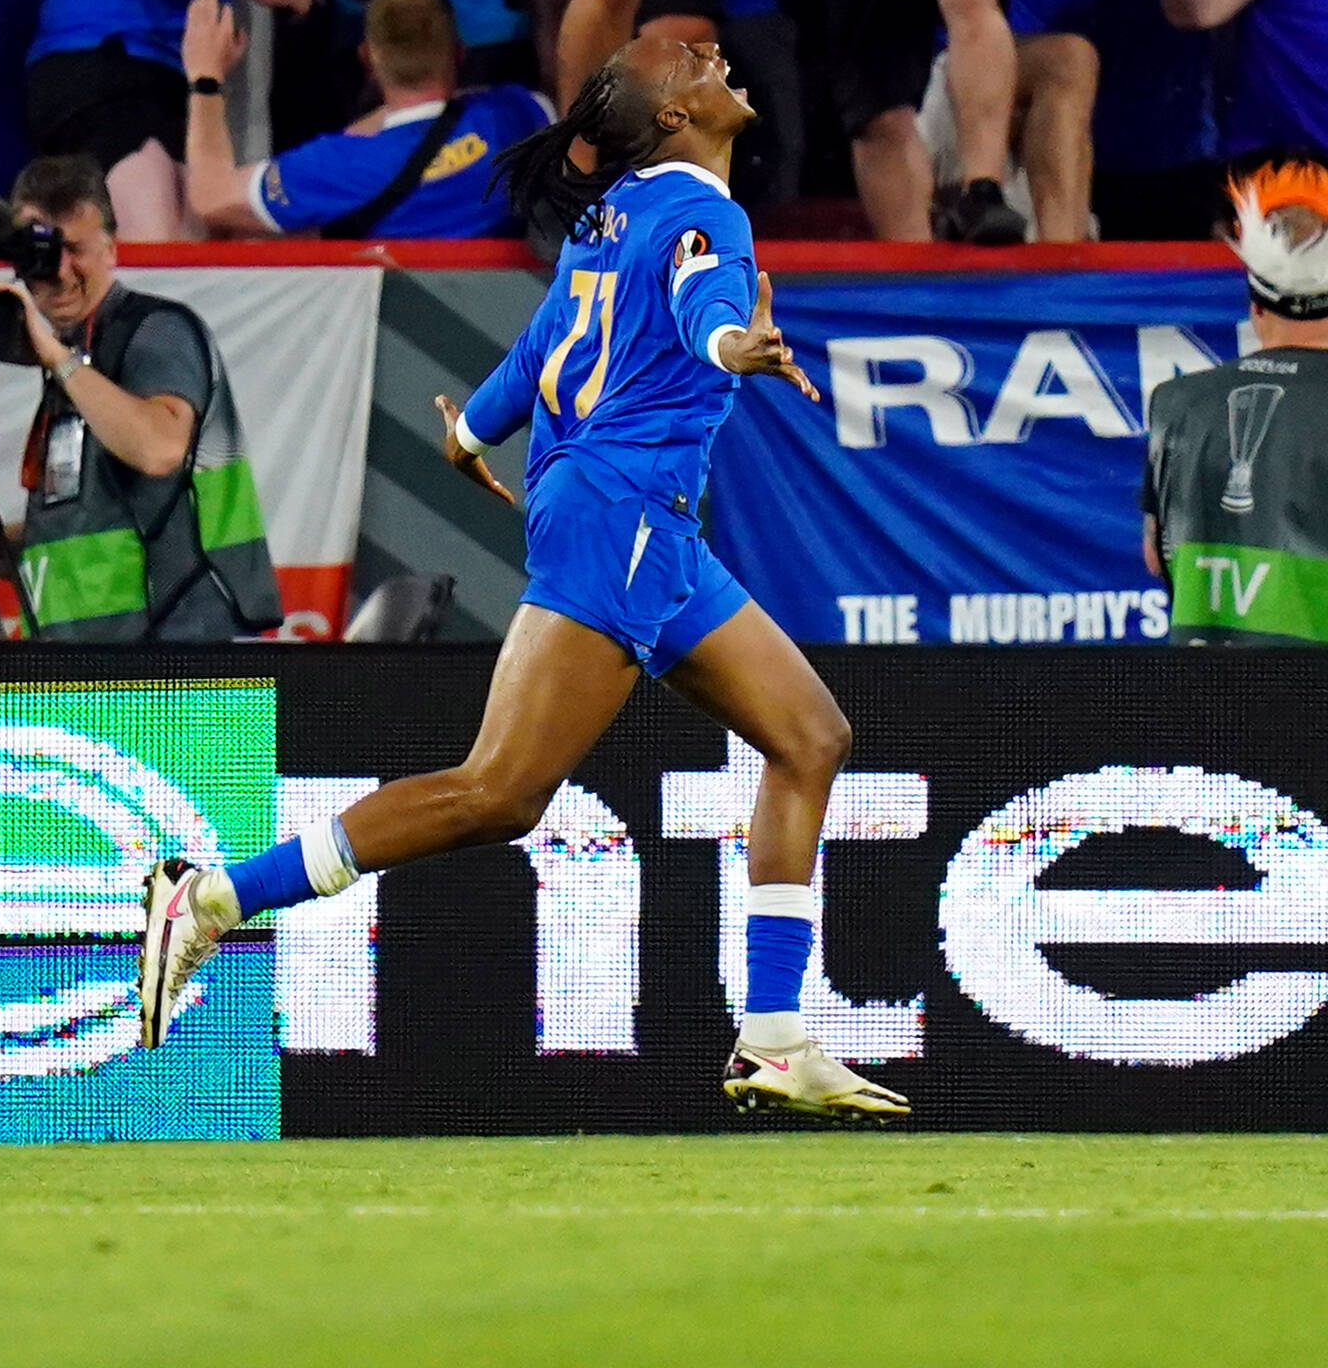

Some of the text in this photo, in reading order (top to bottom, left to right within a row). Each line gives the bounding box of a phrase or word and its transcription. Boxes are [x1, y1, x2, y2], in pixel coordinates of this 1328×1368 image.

[1194, 556, 1271, 617] TV
[837, 589, 1170, 644] THE MURPHY'S
